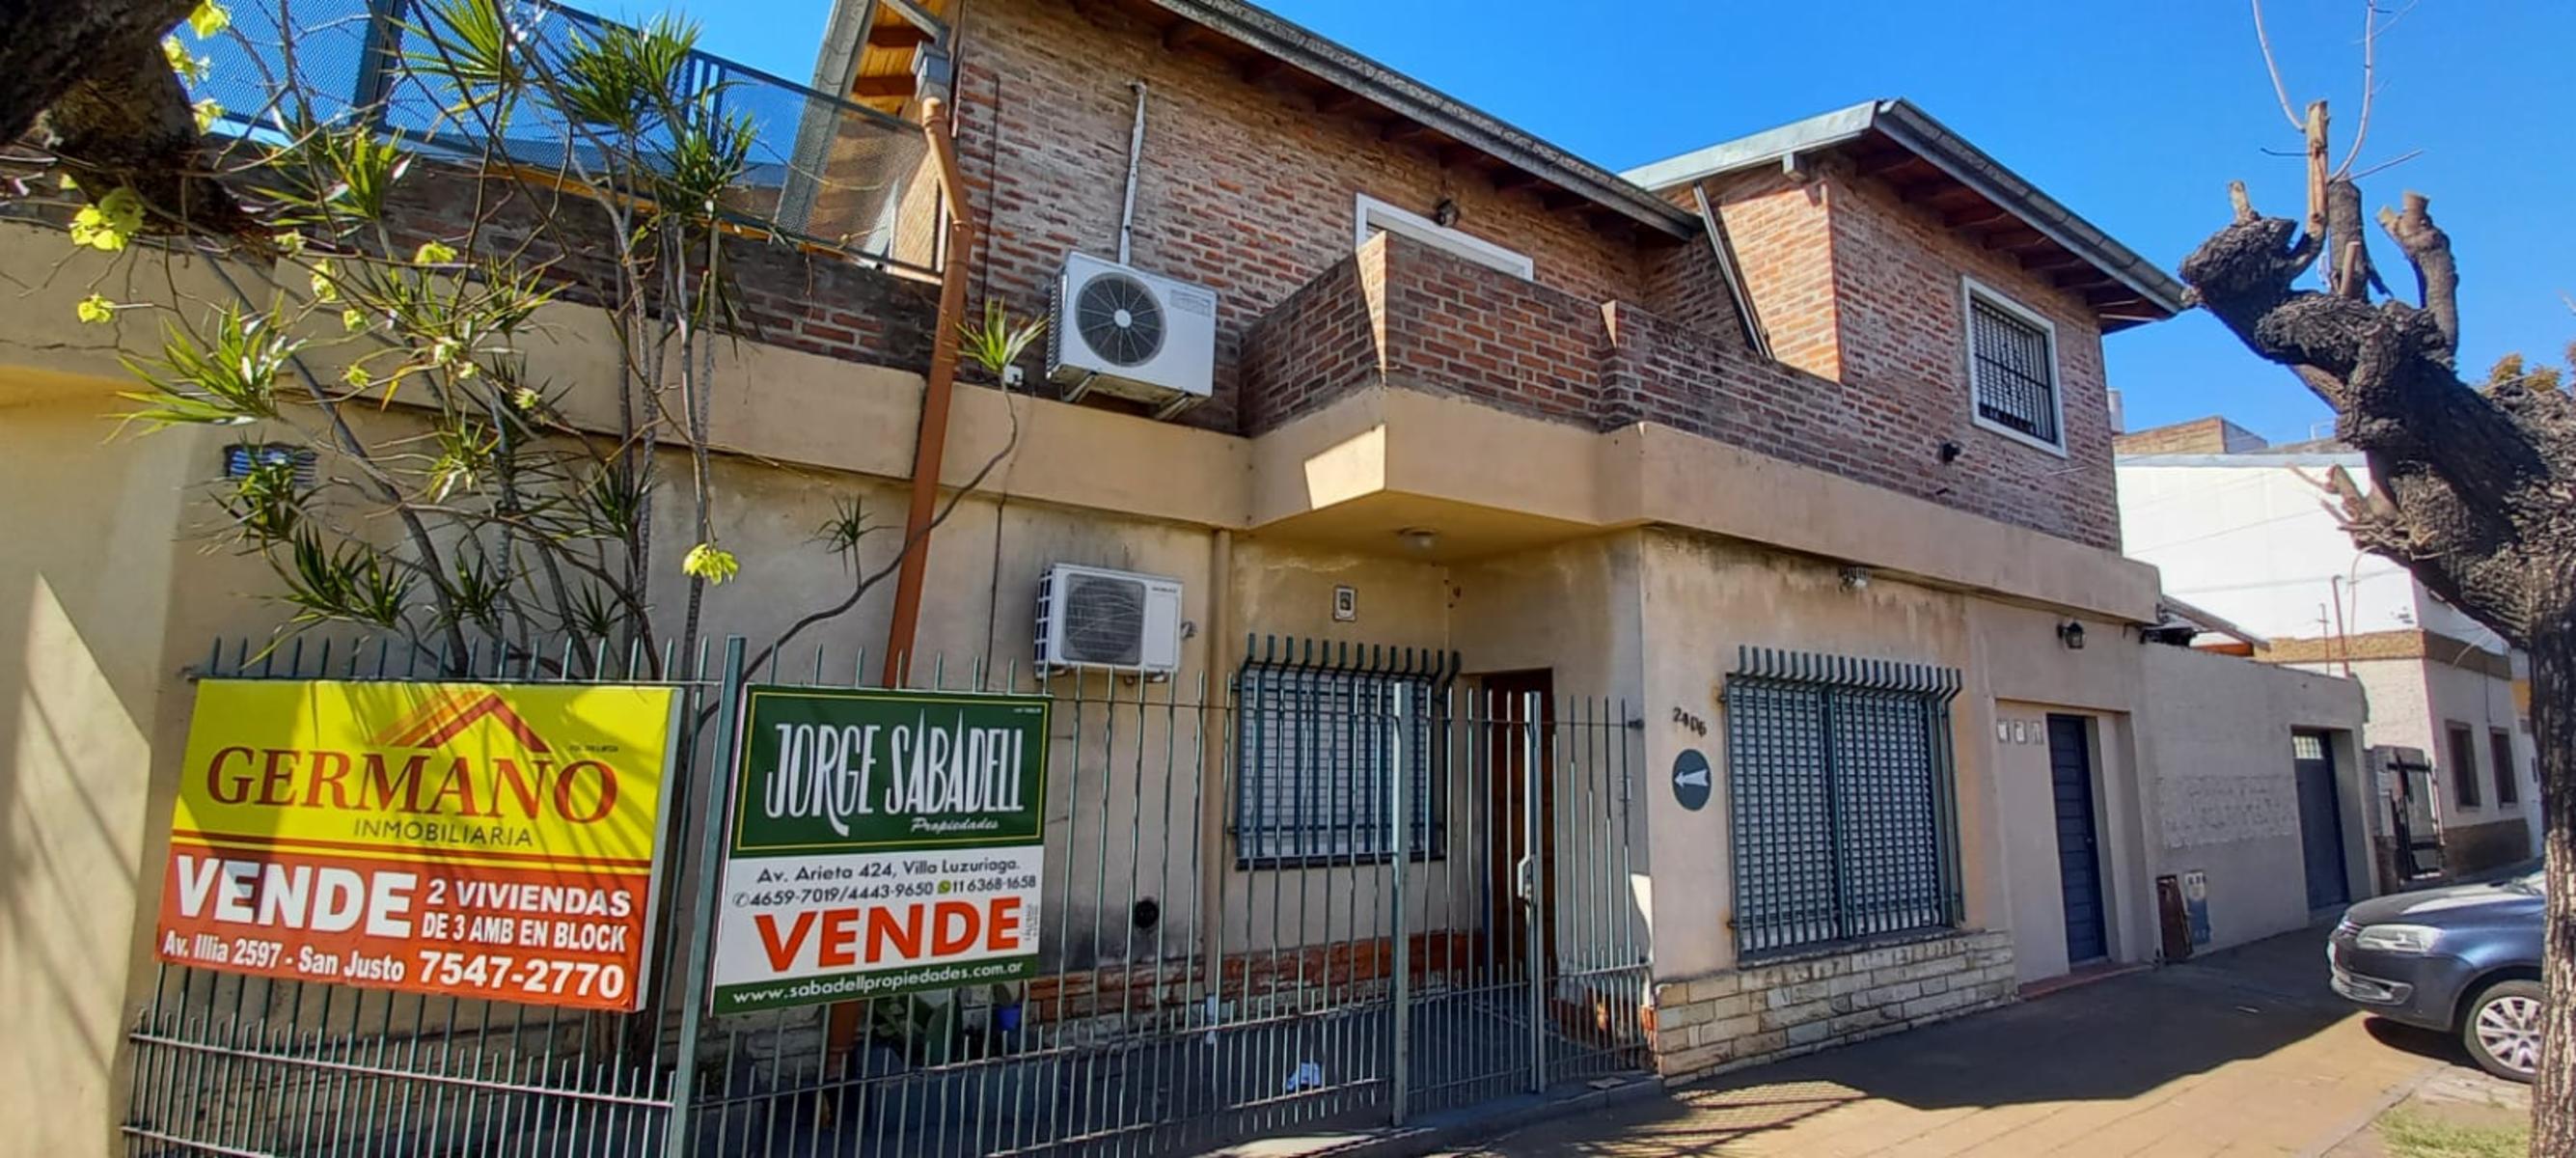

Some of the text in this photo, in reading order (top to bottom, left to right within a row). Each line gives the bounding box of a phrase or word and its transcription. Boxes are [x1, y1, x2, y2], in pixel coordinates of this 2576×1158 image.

[1673, 706, 1707, 737] 2406
[206, 746, 620, 824] GERMANO
[764, 708, 1024, 837] JORGE SABADELL
[353, 818, 534, 847] INMOBILIARIA
[911, 816, 1000, 834] Propiedades
[756, 868, 788, 884] Av.
[795, 865, 853, 881] Arieta
[858, 862, 897, 878] 424,
[903, 859, 938, 875] Villa
[952, 880, 964, 894] 11
[967, 875, 1036, 893] 6368-1658
[177, 855, 418, 939] VENDE
[426, 878, 632, 918] 2 VIVIENDAS
[422, 912, 628, 952] DE 3 AMB EN BLOCK
[754, 896, 1022, 974] VENDE
[163, 930, 188, 957] Av.
[194, 933, 229, 962] Illia
[233, 938, 283, 969] 2597
[298, 945, 339, 975] San
[343, 950, 405, 982] Justo
[420, 951, 626, 999] 7547-2770
[733, 962, 1024, 1004] www.sabadellpropiedades.com.ar
